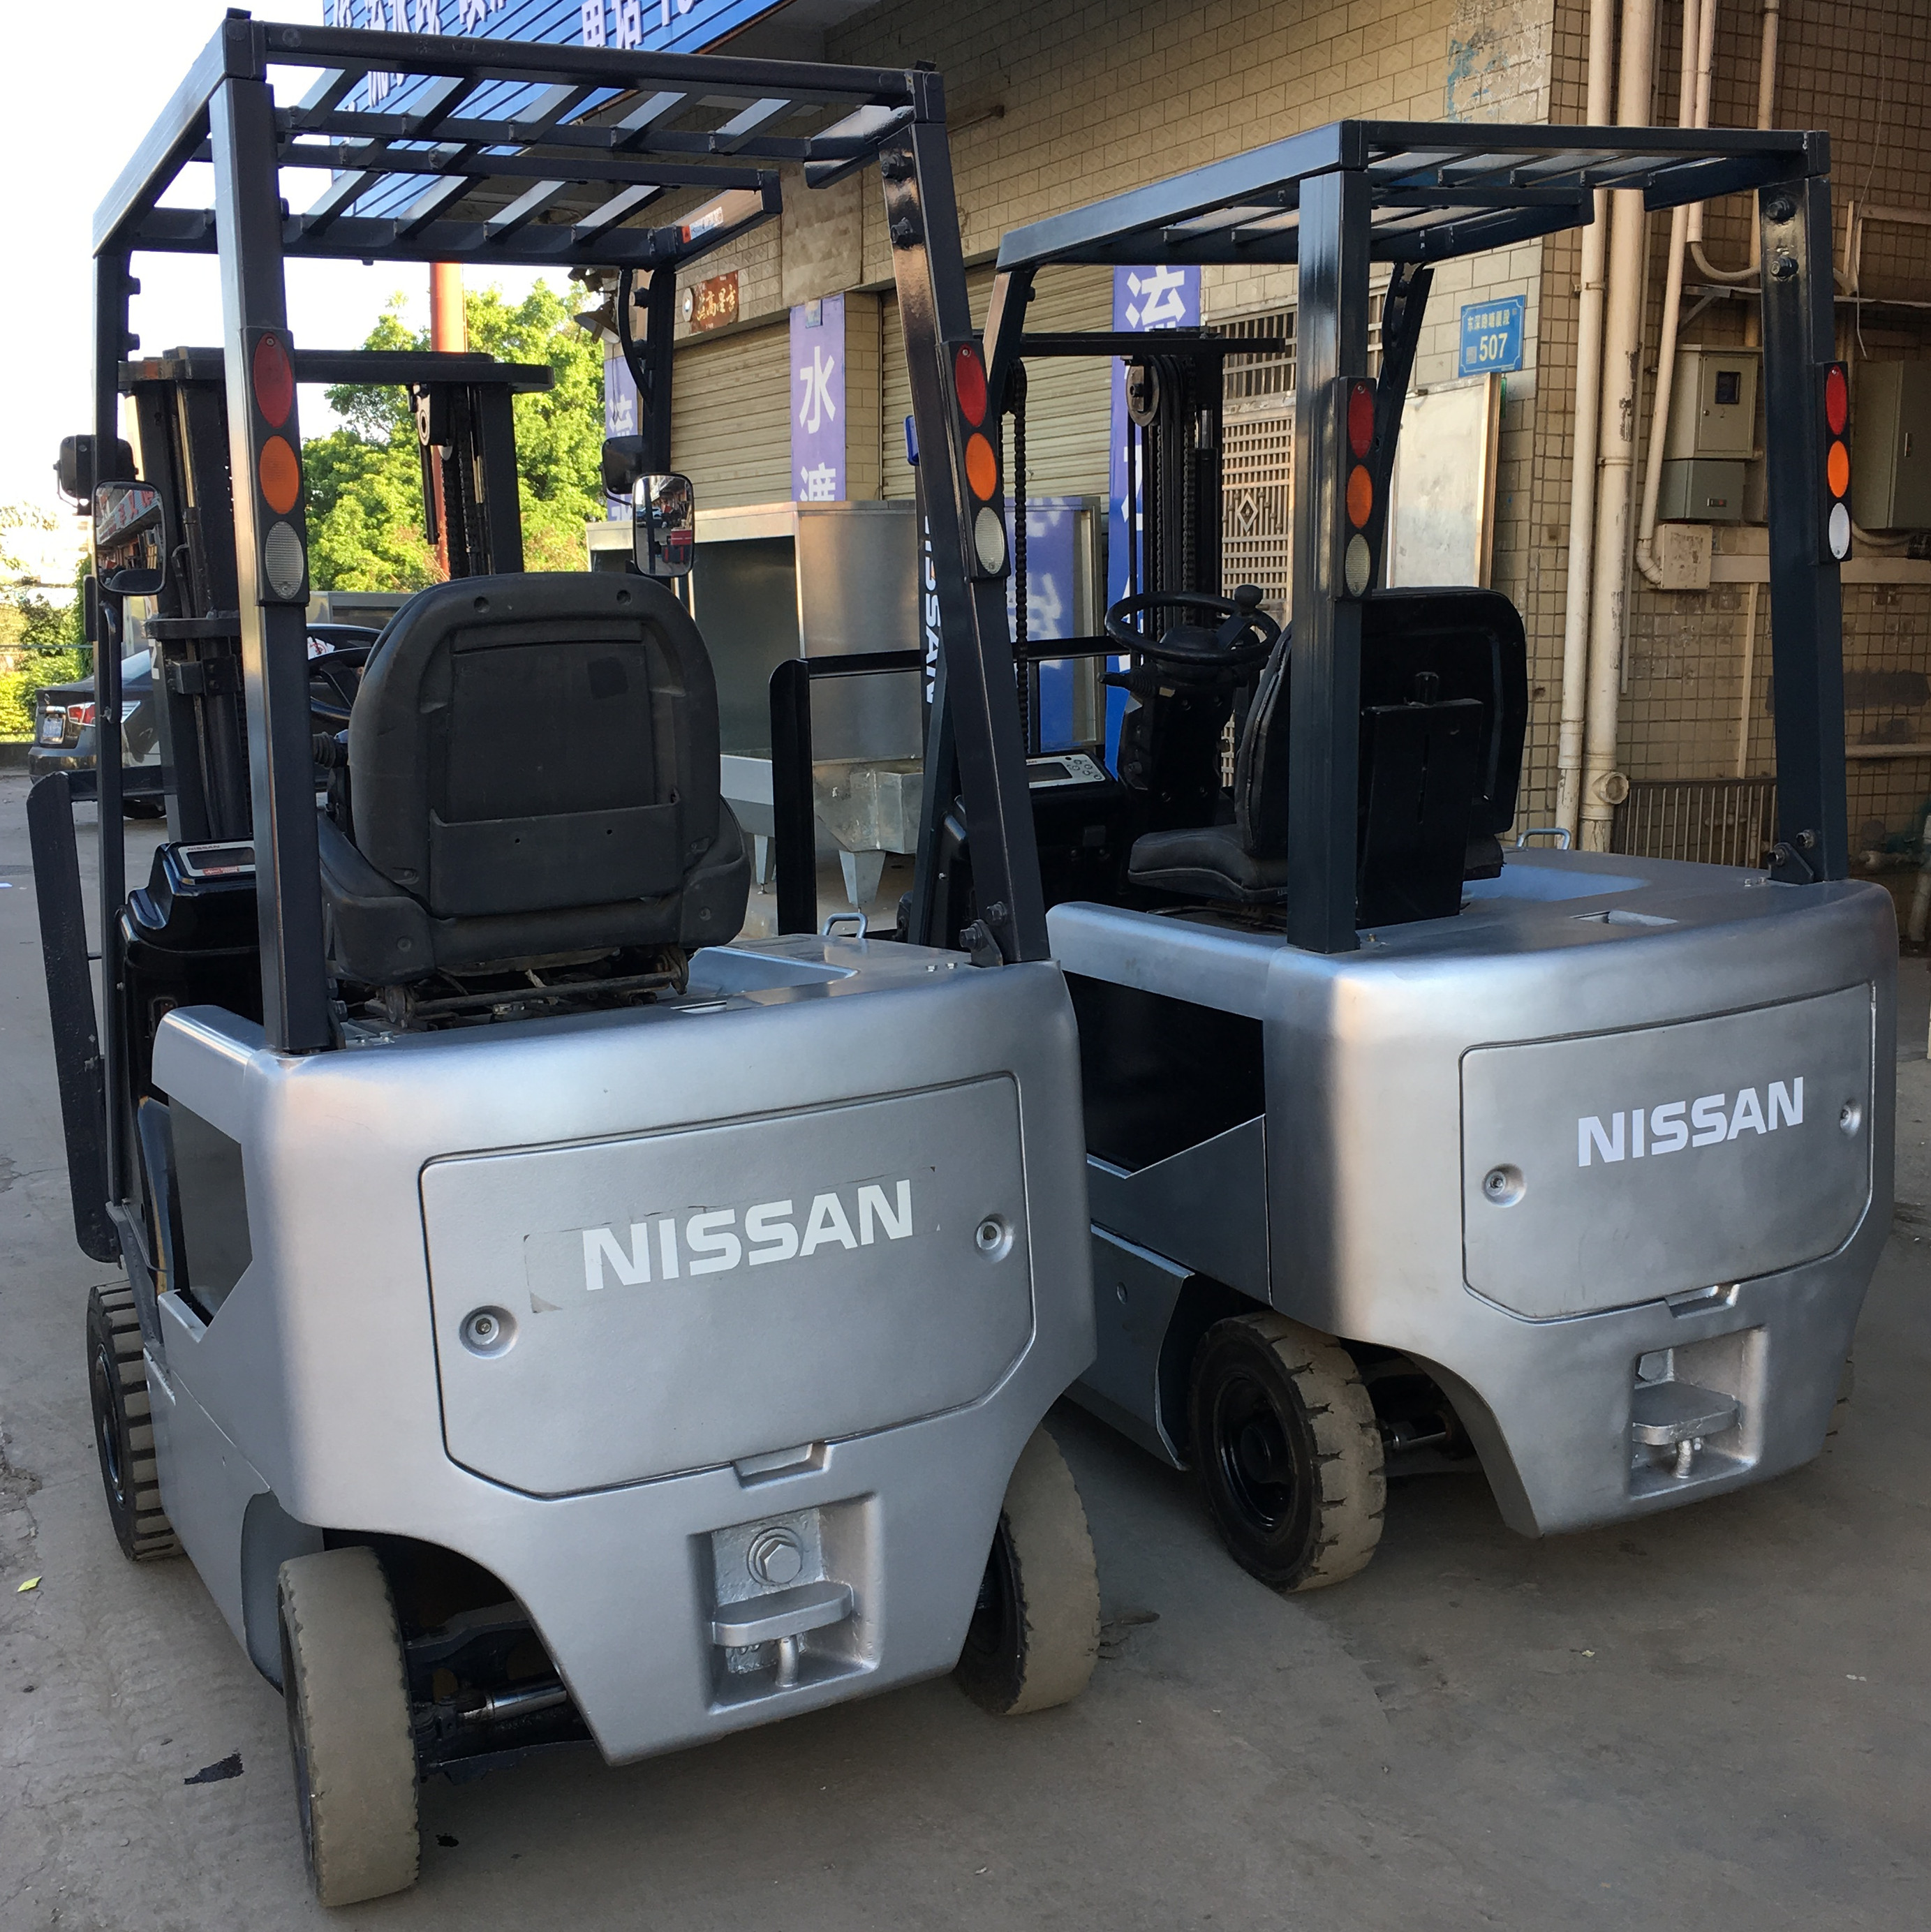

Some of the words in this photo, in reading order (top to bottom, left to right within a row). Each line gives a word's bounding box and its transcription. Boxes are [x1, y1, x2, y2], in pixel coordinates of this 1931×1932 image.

[1479, 332, 1508, 362] 507
[1578, 1076, 1803, 1167] NISSAN
[582, 1180, 913, 1291] NISSAN
